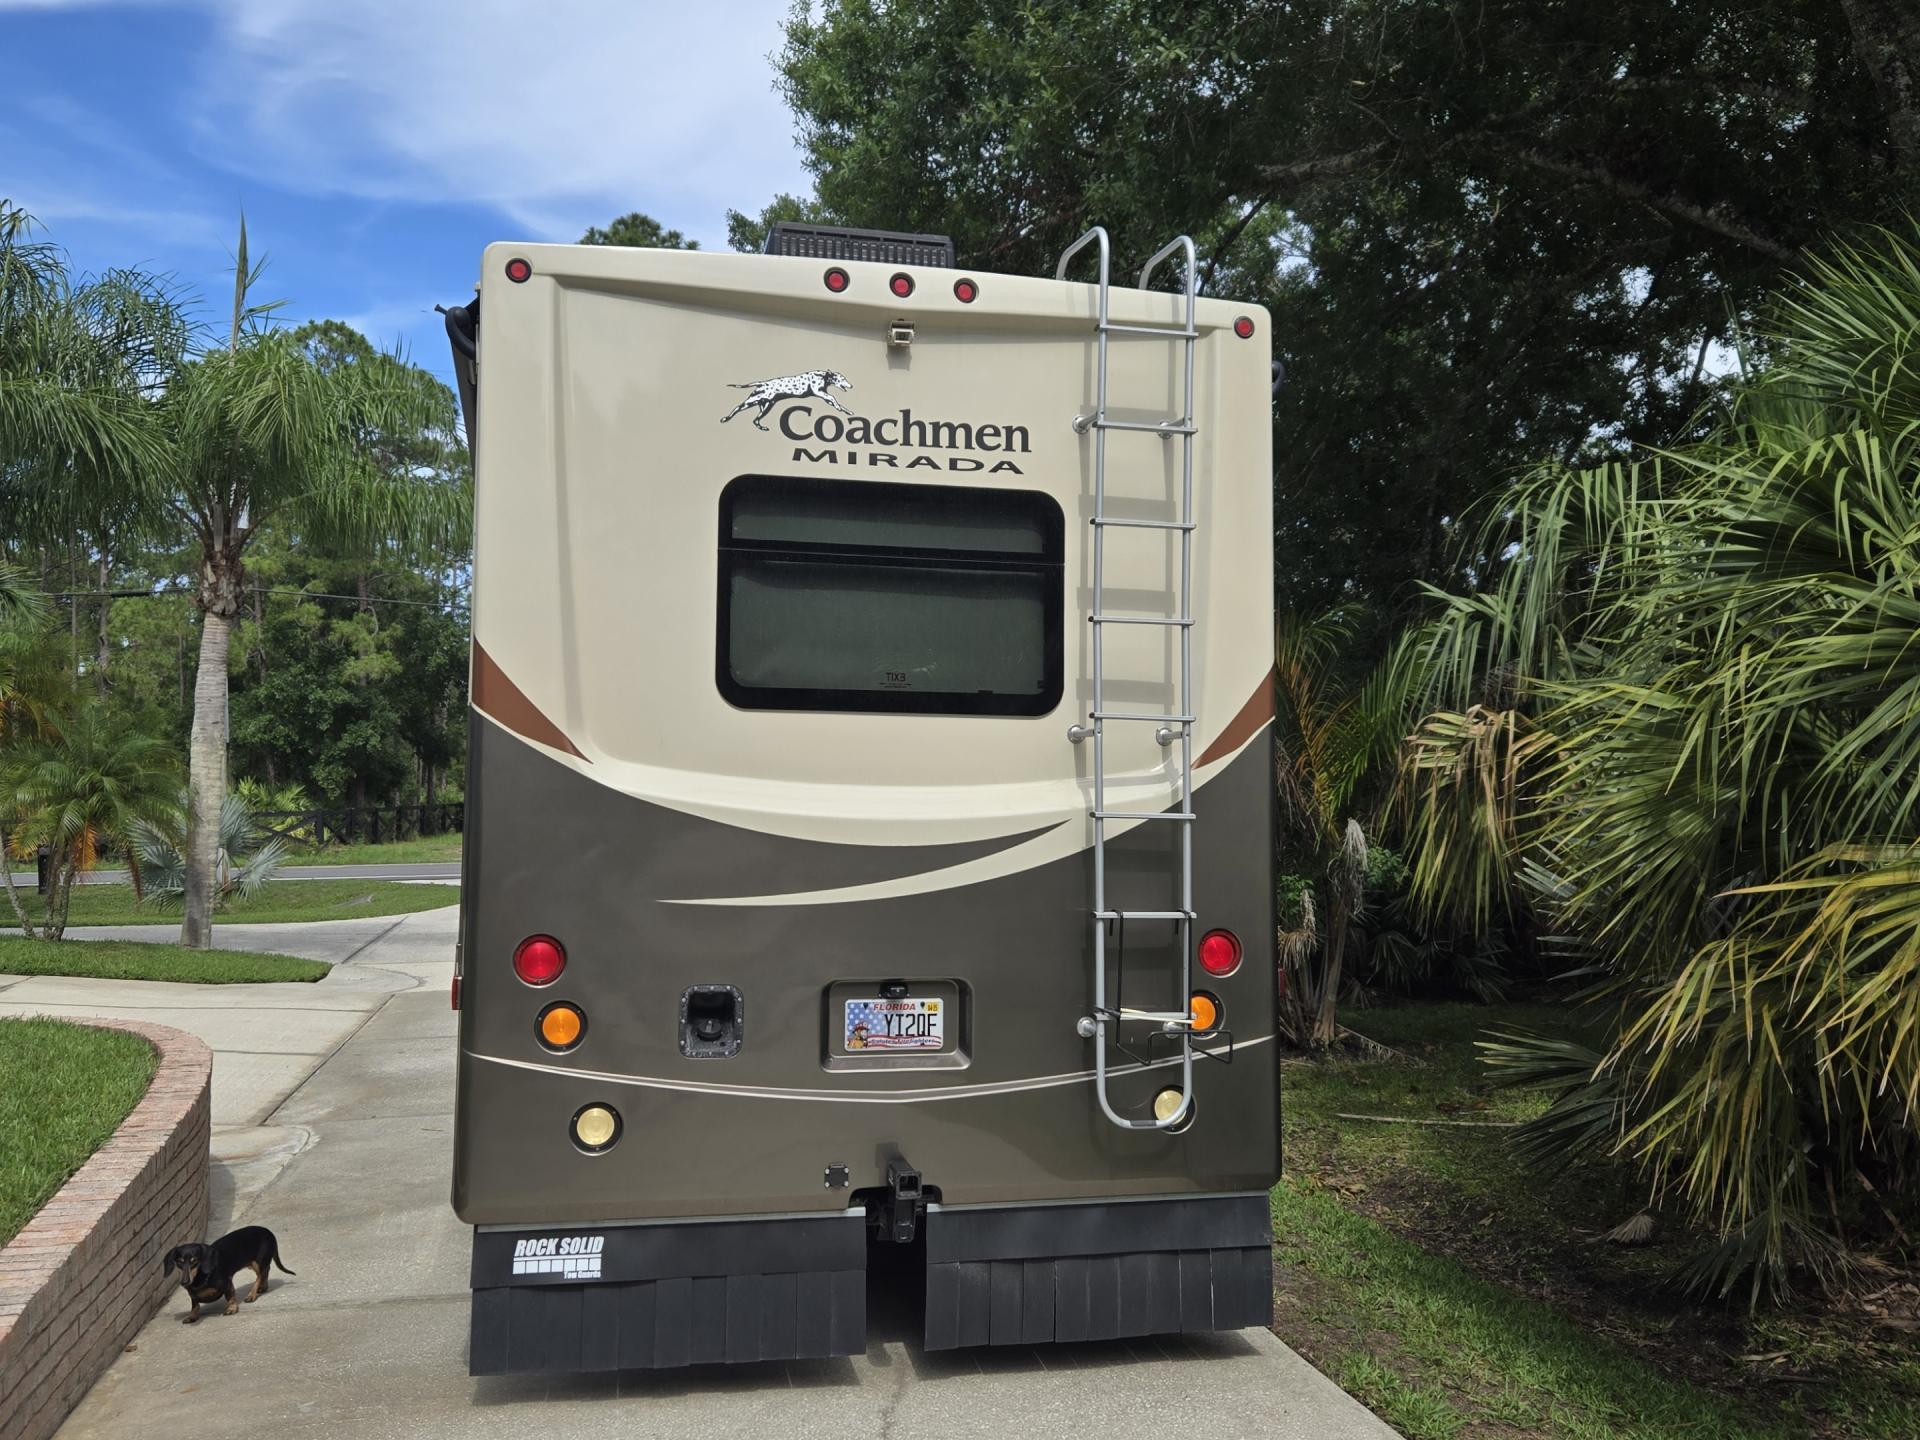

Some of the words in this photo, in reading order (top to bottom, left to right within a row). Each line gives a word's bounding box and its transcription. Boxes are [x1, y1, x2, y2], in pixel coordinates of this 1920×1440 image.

[779, 405, 1032, 453] Coachmen
[792, 448, 1025, 475] MIRADA
[873, 1003, 916, 1011] FLORIDA
[514, 1238, 560, 1257] ROCK
[559, 1236, 605, 1255] SOLID
